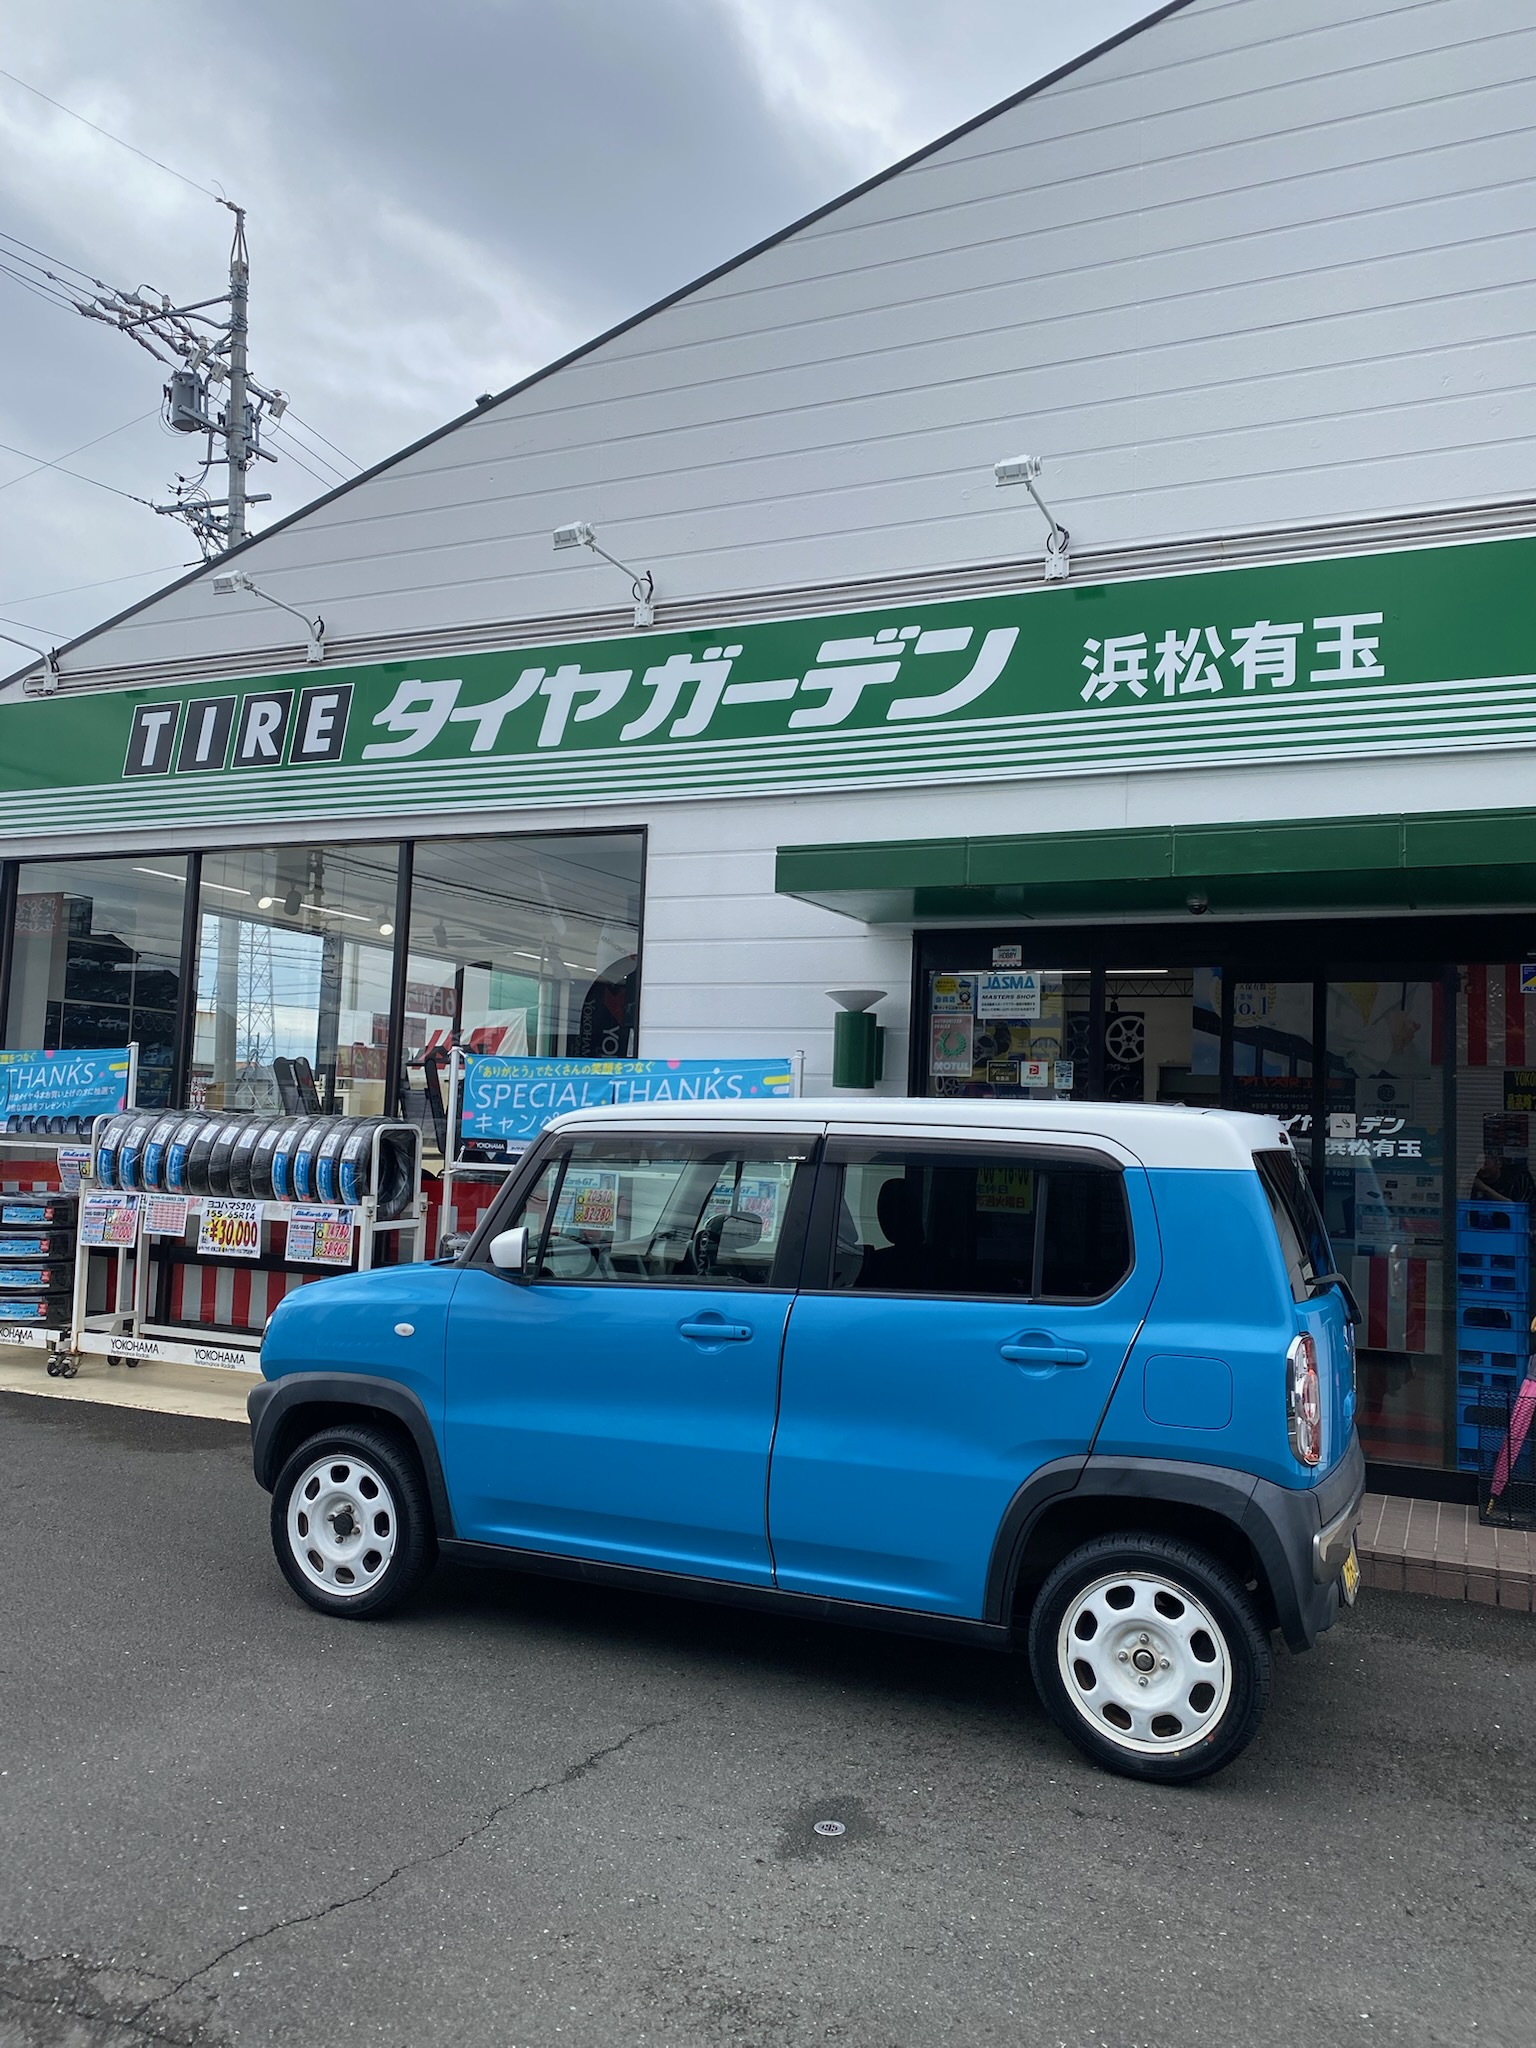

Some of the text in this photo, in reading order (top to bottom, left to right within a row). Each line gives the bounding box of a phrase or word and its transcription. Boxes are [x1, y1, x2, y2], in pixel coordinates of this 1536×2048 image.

[1080, 611, 1386, 702] 浜松有玉
[362, 625, 1020, 760] タイヤガーデン
[140, 692, 339, 768] TIRE
[982, 976, 1035, 990] JASMA
[6, 1063, 96, 1089] THANKS
[933, 1062, 969, 1071] MOTUL
[475, 1074, 744, 1109] SPECIAL THANKS
[475, 1142, 505, 1150] YOKOHAMA
[207, 1200, 257, 1211] ヨコハマS306
[209, 1219, 258, 1247] ¥30,000
[110, 1339, 160, 1355] YOKOHAMA
[194, 1348, 246, 1365] YOKOHAMA
